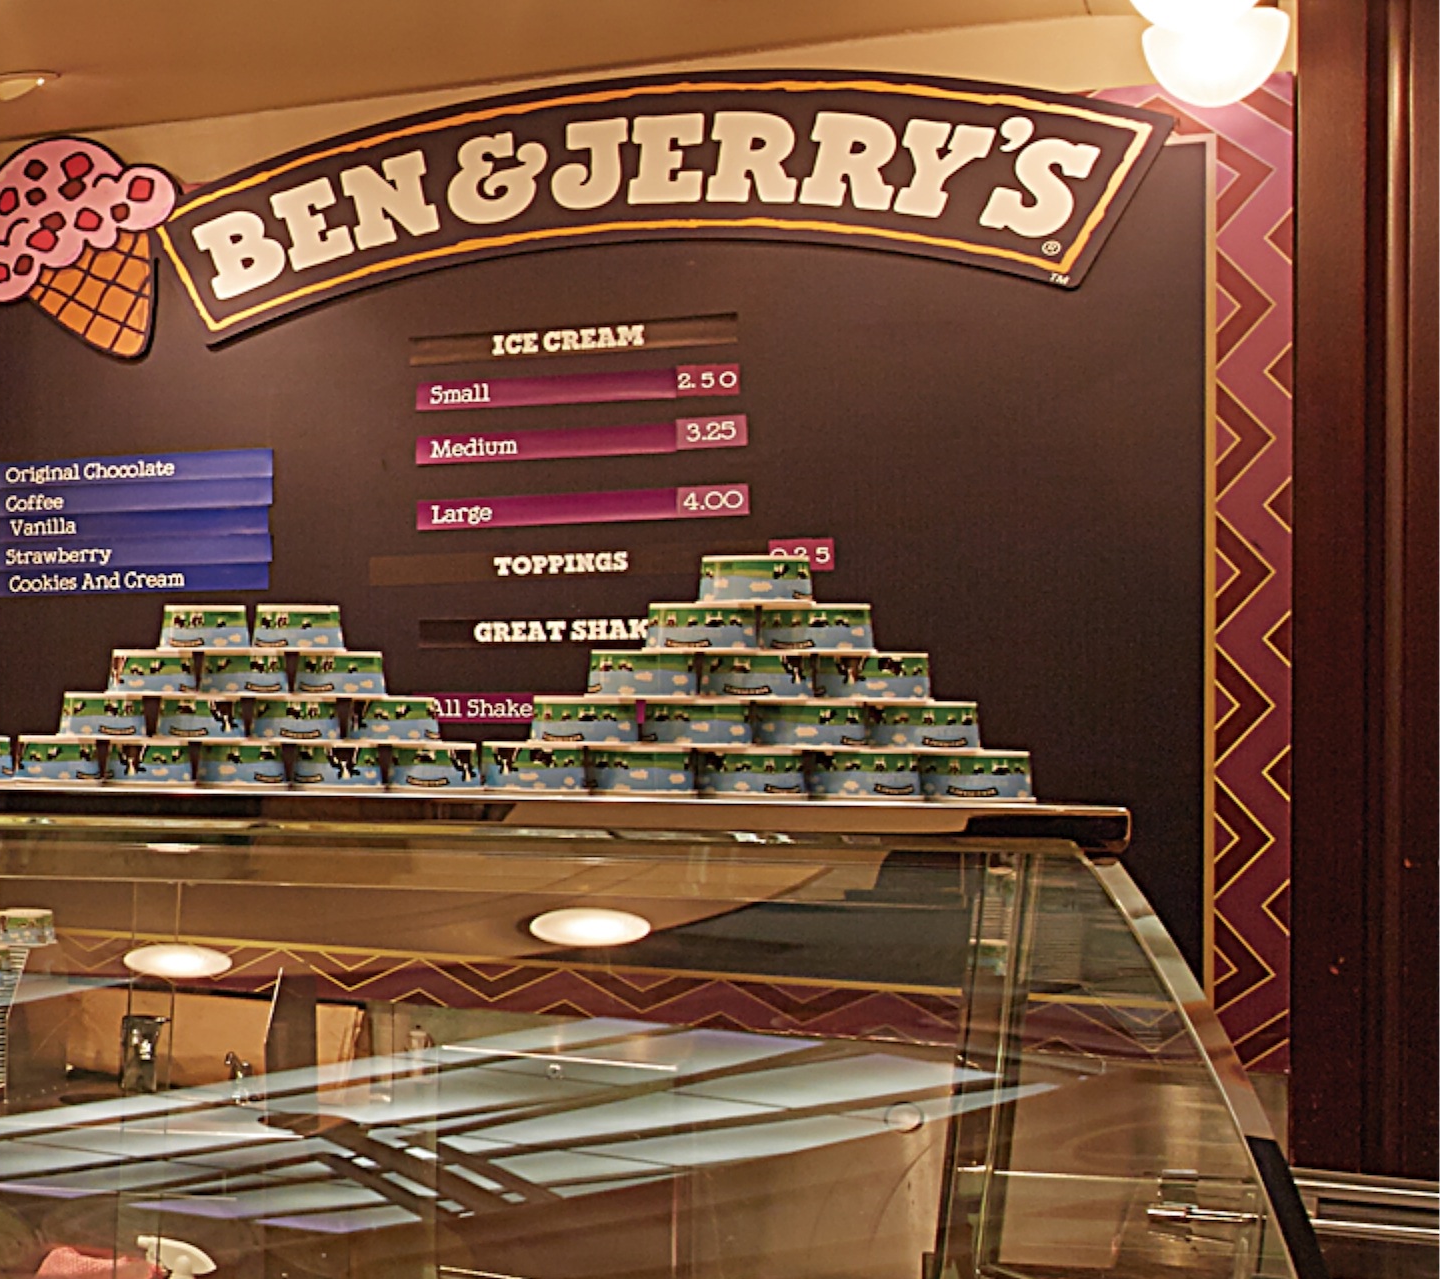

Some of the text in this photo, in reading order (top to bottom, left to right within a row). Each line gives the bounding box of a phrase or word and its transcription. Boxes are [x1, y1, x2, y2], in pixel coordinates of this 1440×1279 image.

[492, 324, 645, 356] ICE CREAM
[429, 384, 490, 404] Small
[430, 422, 736, 458] Medium 3.25
[5, 460, 175, 485] Original Chocolate
[5, 495, 64, 512] Coffee
[431, 490, 744, 525] Large 4.00
[10, 518, 77, 536] Vanilla
[5, 547, 112, 565] Strawberry
[493, 552, 628, 576] TOPPINGS
[9, 570, 185, 592] Cookies And Cream
[474, 619, 648, 643] GREAT SHAK
[432, 699, 461, 718] All
